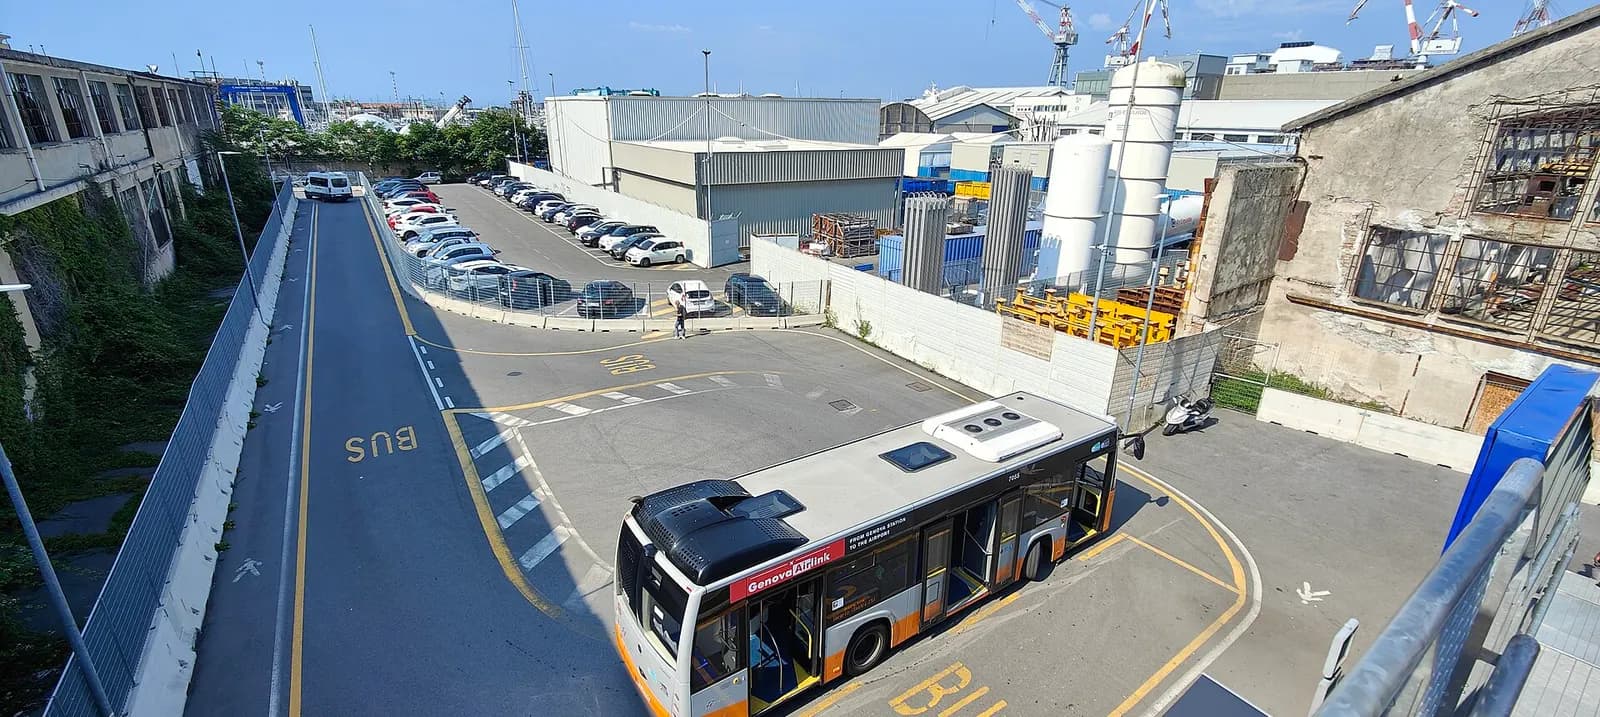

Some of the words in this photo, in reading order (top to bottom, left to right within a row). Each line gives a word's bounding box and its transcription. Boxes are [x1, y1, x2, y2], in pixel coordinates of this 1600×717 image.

[600, 354, 656, 376] BUS
[345, 425, 418, 463] BUS
[849, 533, 865, 544] FROM
[865, 525, 886, 537] GENOVA
[886, 517, 906, 529] STATION
[849, 543, 857, 551] TO
[857, 539, 867, 547] THE
[868, 529, 890, 543] AIRPORT
